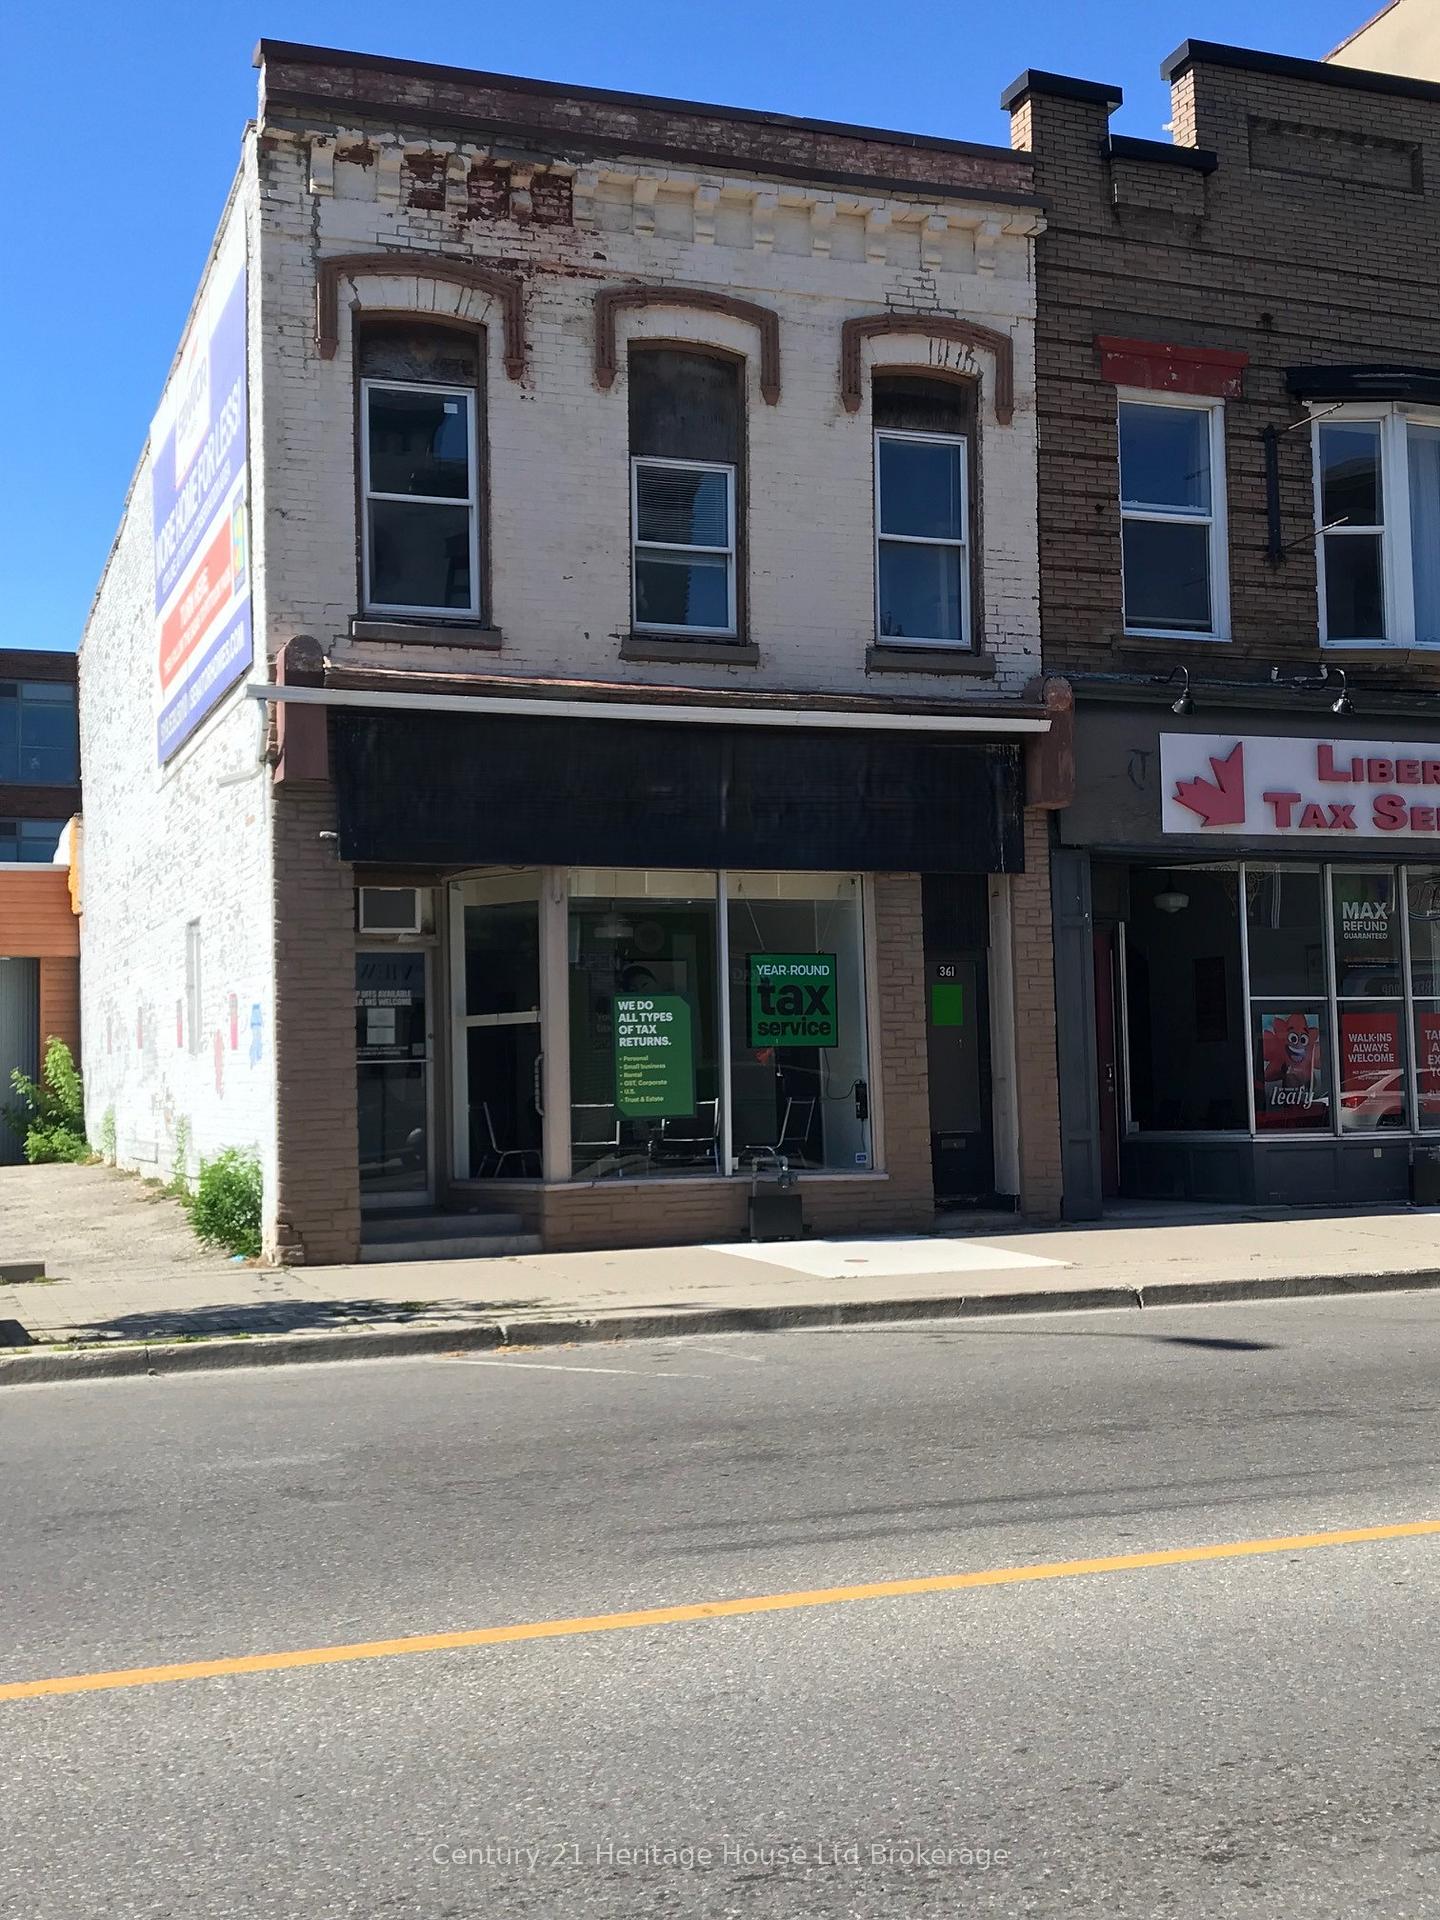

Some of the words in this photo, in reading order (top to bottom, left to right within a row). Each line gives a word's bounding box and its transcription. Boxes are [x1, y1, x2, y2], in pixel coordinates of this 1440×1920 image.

[155, 507, 175, 582] MORE
[175, 462, 197, 545] HOME
[198, 429, 214, 503] FOR
[215, 374, 241, 470] LESS!
[1263, 792, 1358, 829] TAX
[1372, 793, 1440, 831] SE
[1342, 901, 1388, 919] MAX
[1343, 921, 1388, 932] REFUND
[1343, 932, 1388, 940] GUARANTEED
[756, 965, 830, 976] YEAR-ROUND
[939, 966, 955, 977] 361
[757, 980, 830, 1016] tax
[618, 1001, 635, 1010] WE
[637, 1001, 653, 1010] DO
[618, 1013, 638, 1022] ALL
[640, 1012, 673, 1022] TYPES
[618, 1025, 634, 1035] OF
[635, 1025, 657, 1034] TAX
[757, 1016, 831, 1036] service
[619, 1036, 672, 1047] RETURNS.
[1348, 1033, 1393, 1042] WALK-INS
[1352, 1043, 1390, 1052] ALWAYS
[1347, 1053, 1395, 1063] WELCOME
[1271, 1085, 1315, 1109] leafy
